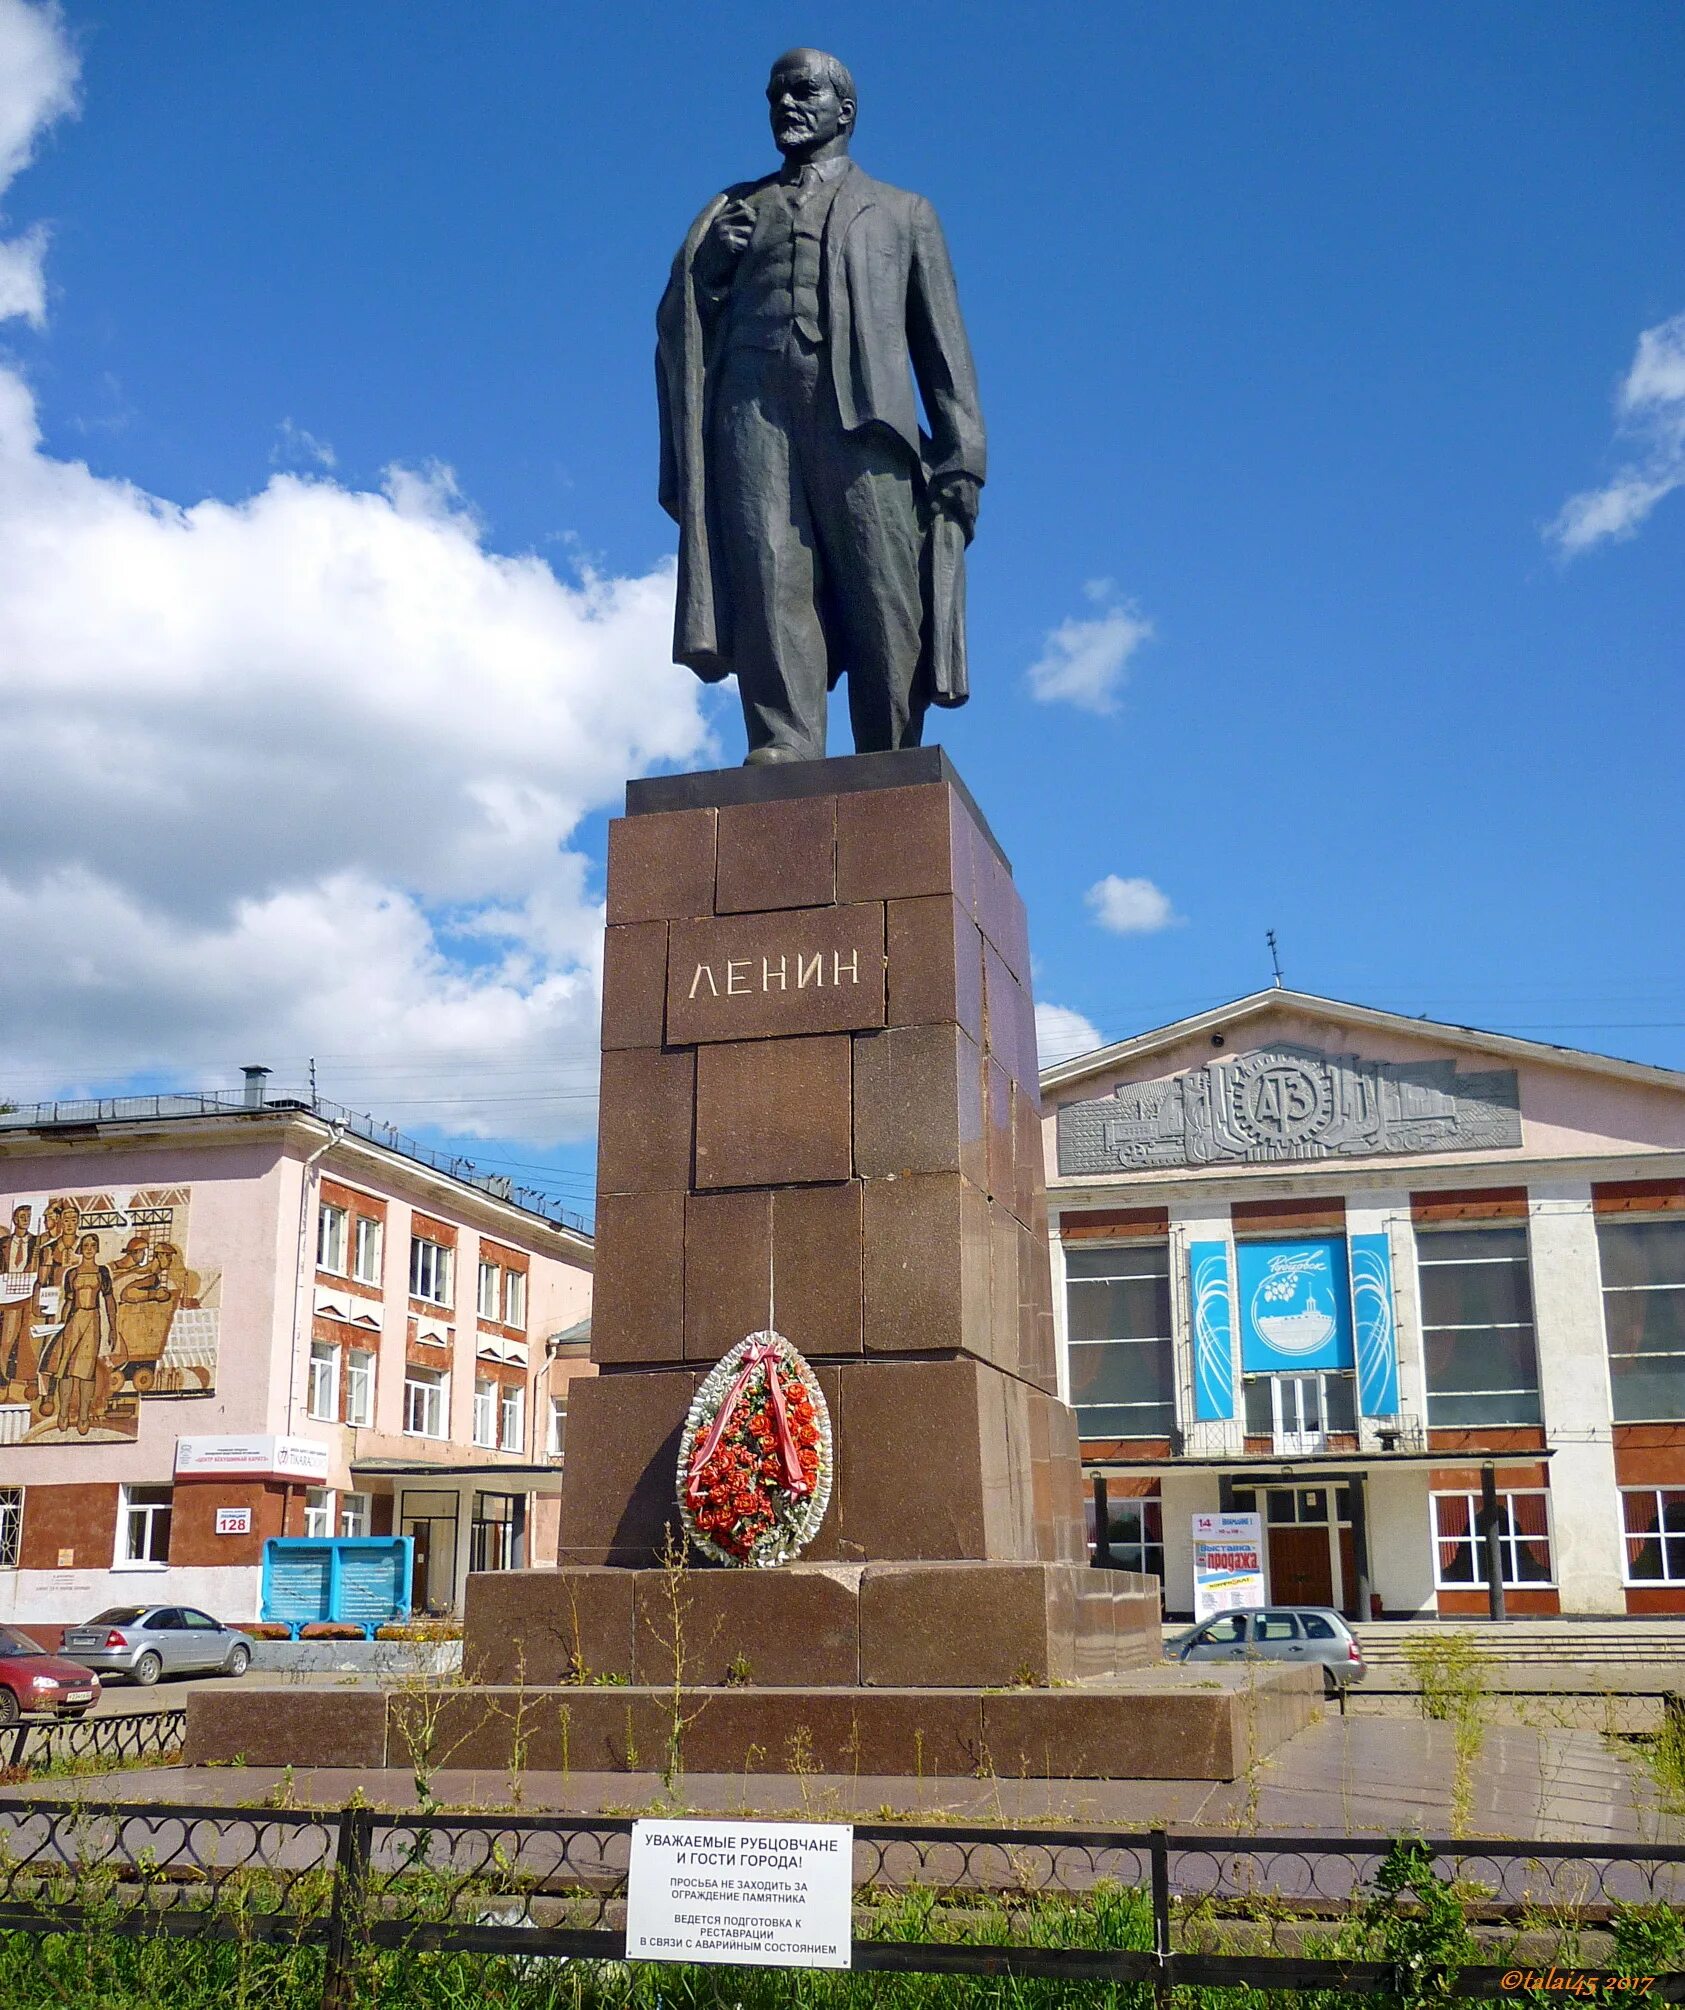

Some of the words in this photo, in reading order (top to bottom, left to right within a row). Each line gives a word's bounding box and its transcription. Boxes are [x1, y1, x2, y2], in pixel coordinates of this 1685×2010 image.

[688, 948, 859, 999] ЛЕНИН
[220, 1519, 246, 1531] 128
[1207, 1552, 1257, 1572] продажа
[645, 1834, 736, 1848] УВАЖАЕМЫЕ
[740, 1837, 838, 1852] РУБЦОВЧАНЕ
[677, 1853, 686, 1864] И
[690, 1853, 736, 1866] ГОСТИ
[740, 1855, 803, 1870] ГОРОДА!
[670, 1878, 717, 1888] ПРОСЬБА
[721, 1879, 734, 1889] НЕ
[737, 1880, 791, 1891] ЗАХОДИТЬ
[794, 1882, 807, 1891] ЗА
[672, 1890, 739, 1902] ОГРАЖДЕНИЕ
[743, 1893, 806, 1904] ПАМЯТНИКА
[674, 1914, 721, 1925] ВЕДЕТСЯ
[724, 1917, 792, 1928] ПОДГОТОВКА
[795, 1919, 801, 1928] К
[700, 1928, 774, 1940] РЕСТАВРАЦИИ
[640, 1937, 646, 1946] В
[650, 1938, 683, 1947] СВЯЗИ
[686, 1939, 692, 1948] С
[696, 1938, 761, 1951] АВАРИЙНЫМ
[764, 1943, 837, 1954] СОСТОЯНИЕМ
